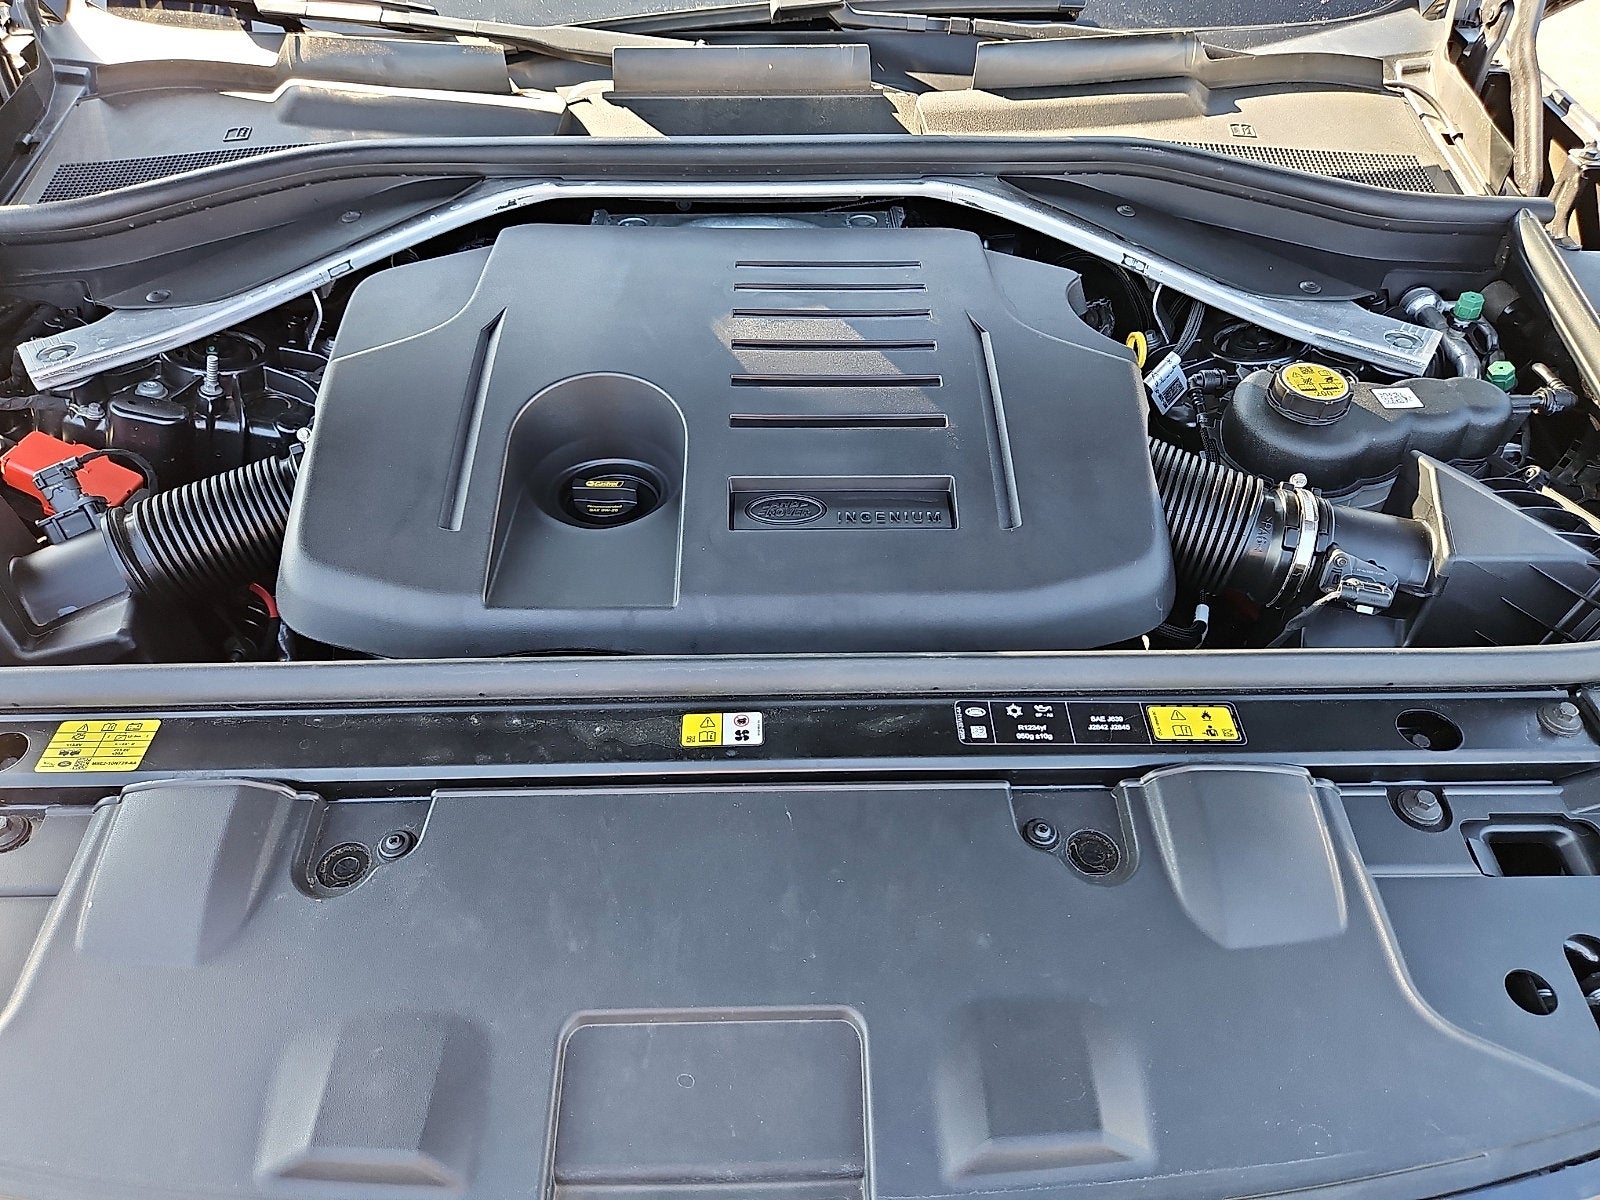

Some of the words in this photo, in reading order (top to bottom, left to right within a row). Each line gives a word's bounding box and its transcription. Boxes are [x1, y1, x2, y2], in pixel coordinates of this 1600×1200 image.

[837, 510, 943, 525] INGENIUM
[1090, 715, 1106, 723] SAE
[1017, 724, 1047, 732] R1234yf
